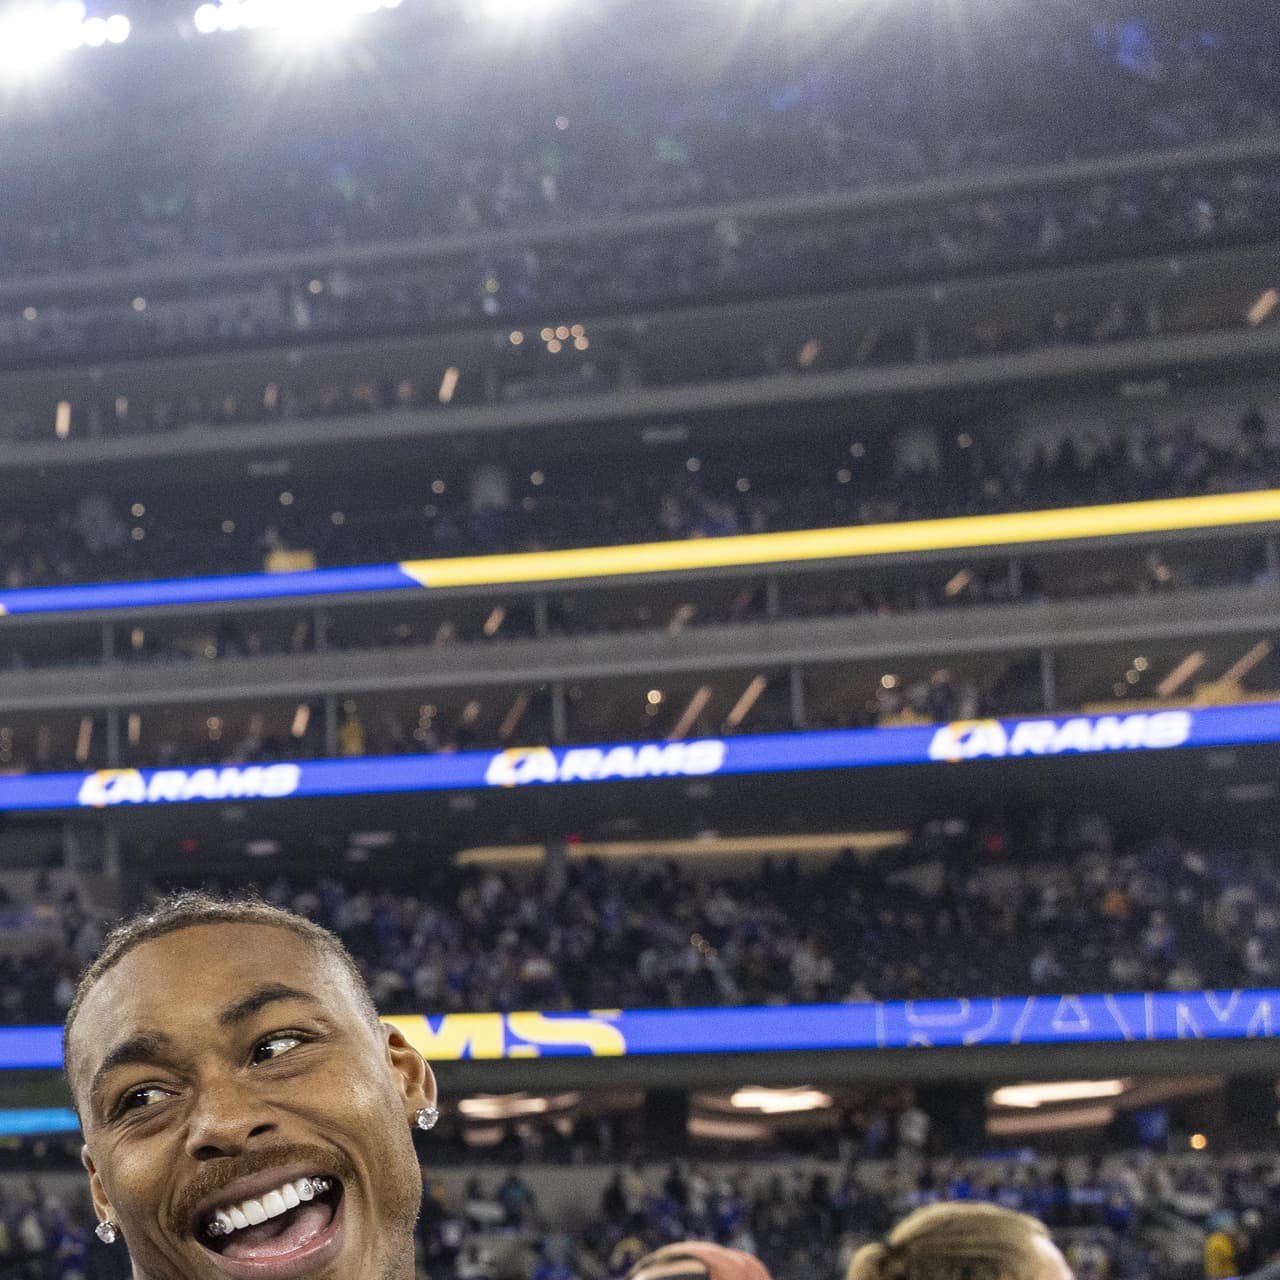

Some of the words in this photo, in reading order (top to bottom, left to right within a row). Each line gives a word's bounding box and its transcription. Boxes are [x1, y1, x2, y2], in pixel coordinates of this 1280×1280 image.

[1009, 711, 1193, 755] RAMS
[560, 740, 726, 781] RAMS
[146, 763, 301, 802] RAMS
